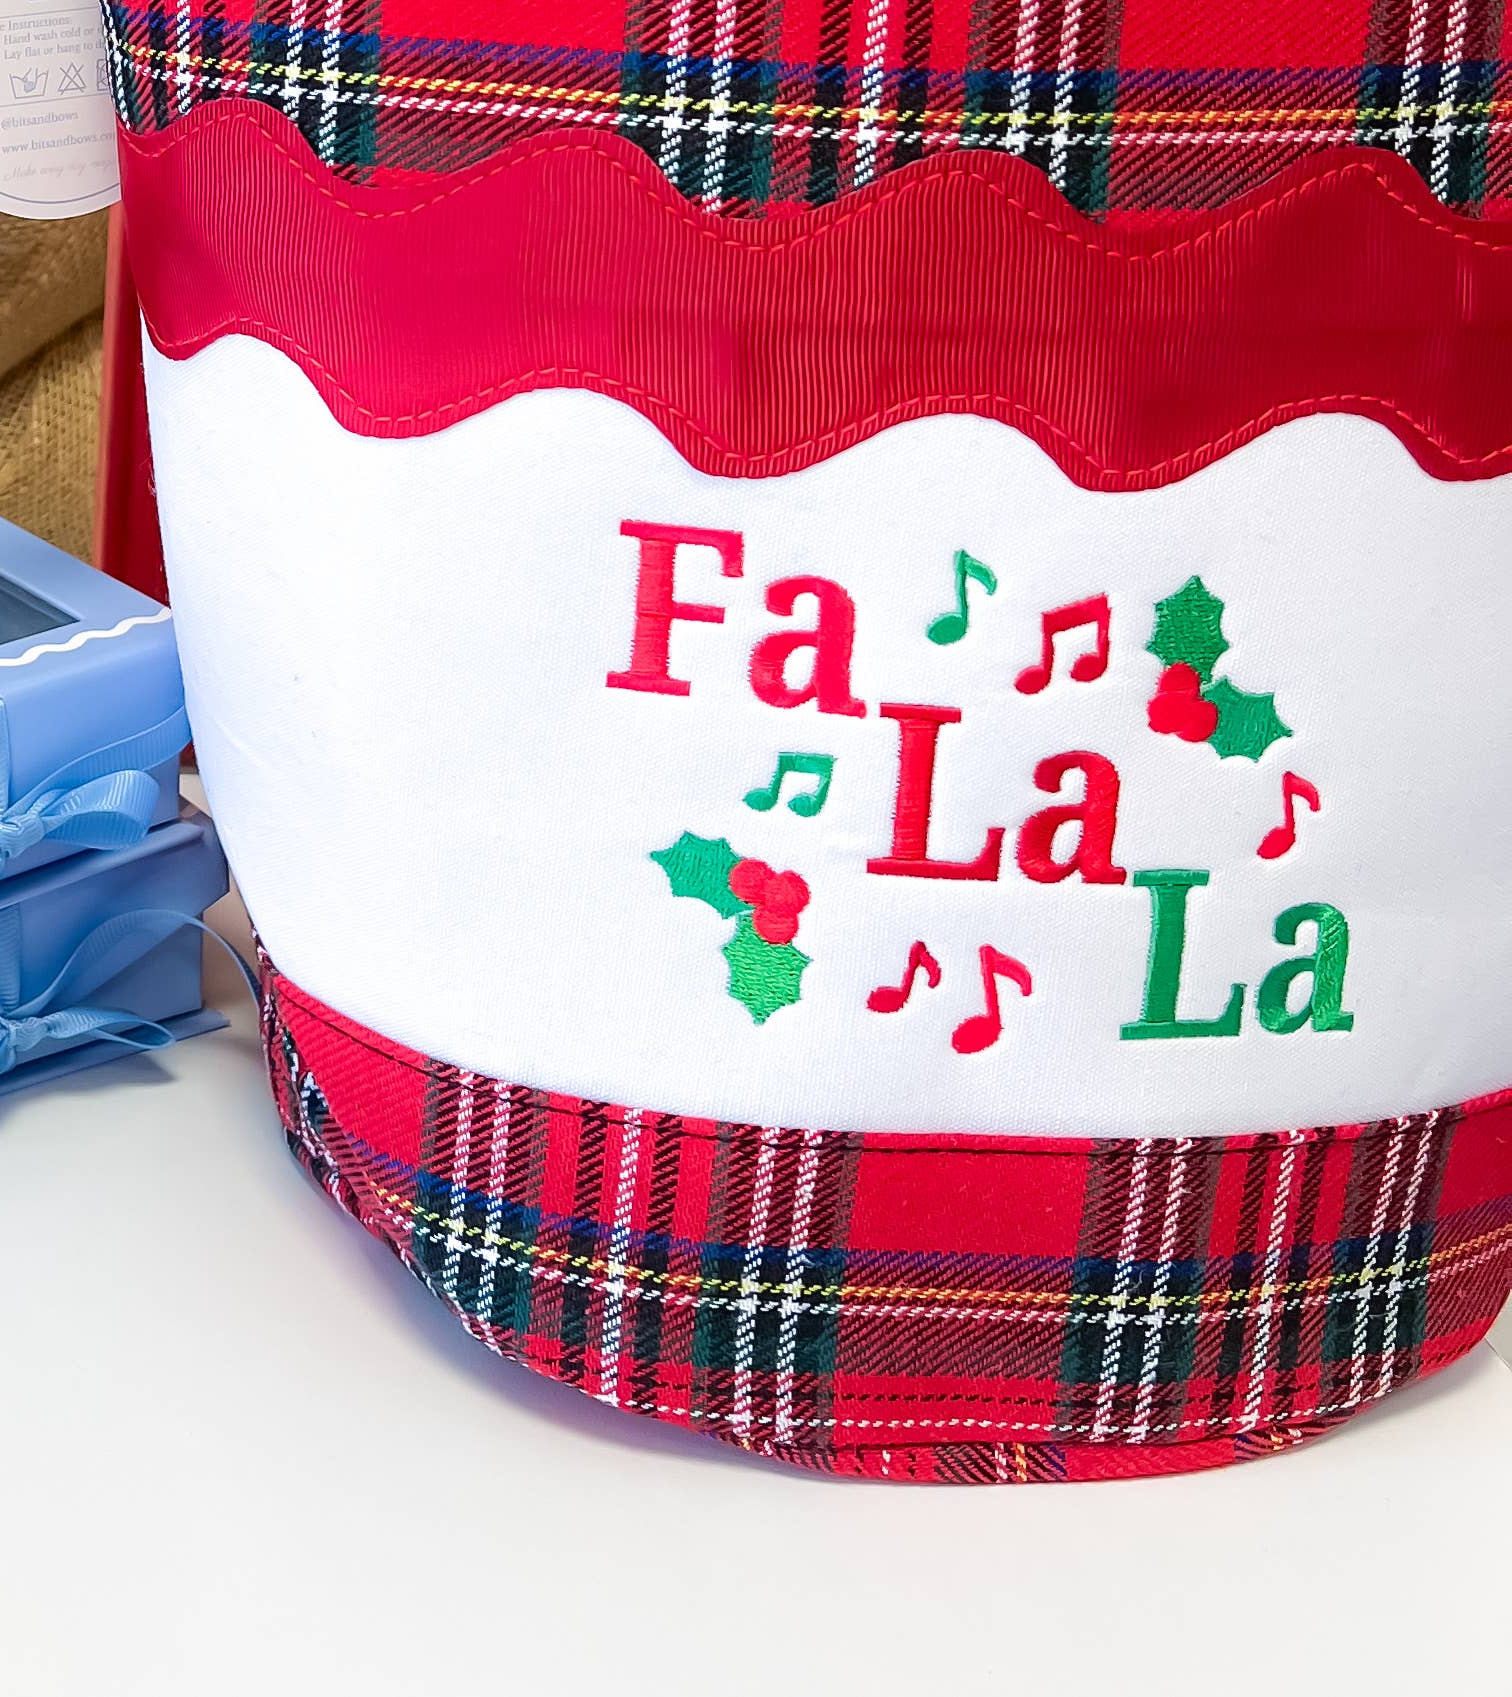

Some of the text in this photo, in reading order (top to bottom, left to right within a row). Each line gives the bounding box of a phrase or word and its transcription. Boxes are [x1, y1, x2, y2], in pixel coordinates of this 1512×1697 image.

[4, 32, 30, 46] Hand
[33, 30, 58, 41] wash
[60, 27, 81, 38] cold
[4, 49, 22, 60] Lay
[25, 46, 41, 57] flat
[44, 47, 55, 56] or
[57, 43, 81, 55] hang
[1, 112, 79, 130] @bitsandbows
[605, 518, 867, 718] Fa
[866, 702, 1127, 884] La
[1119, 867, 1355, 1041] La
